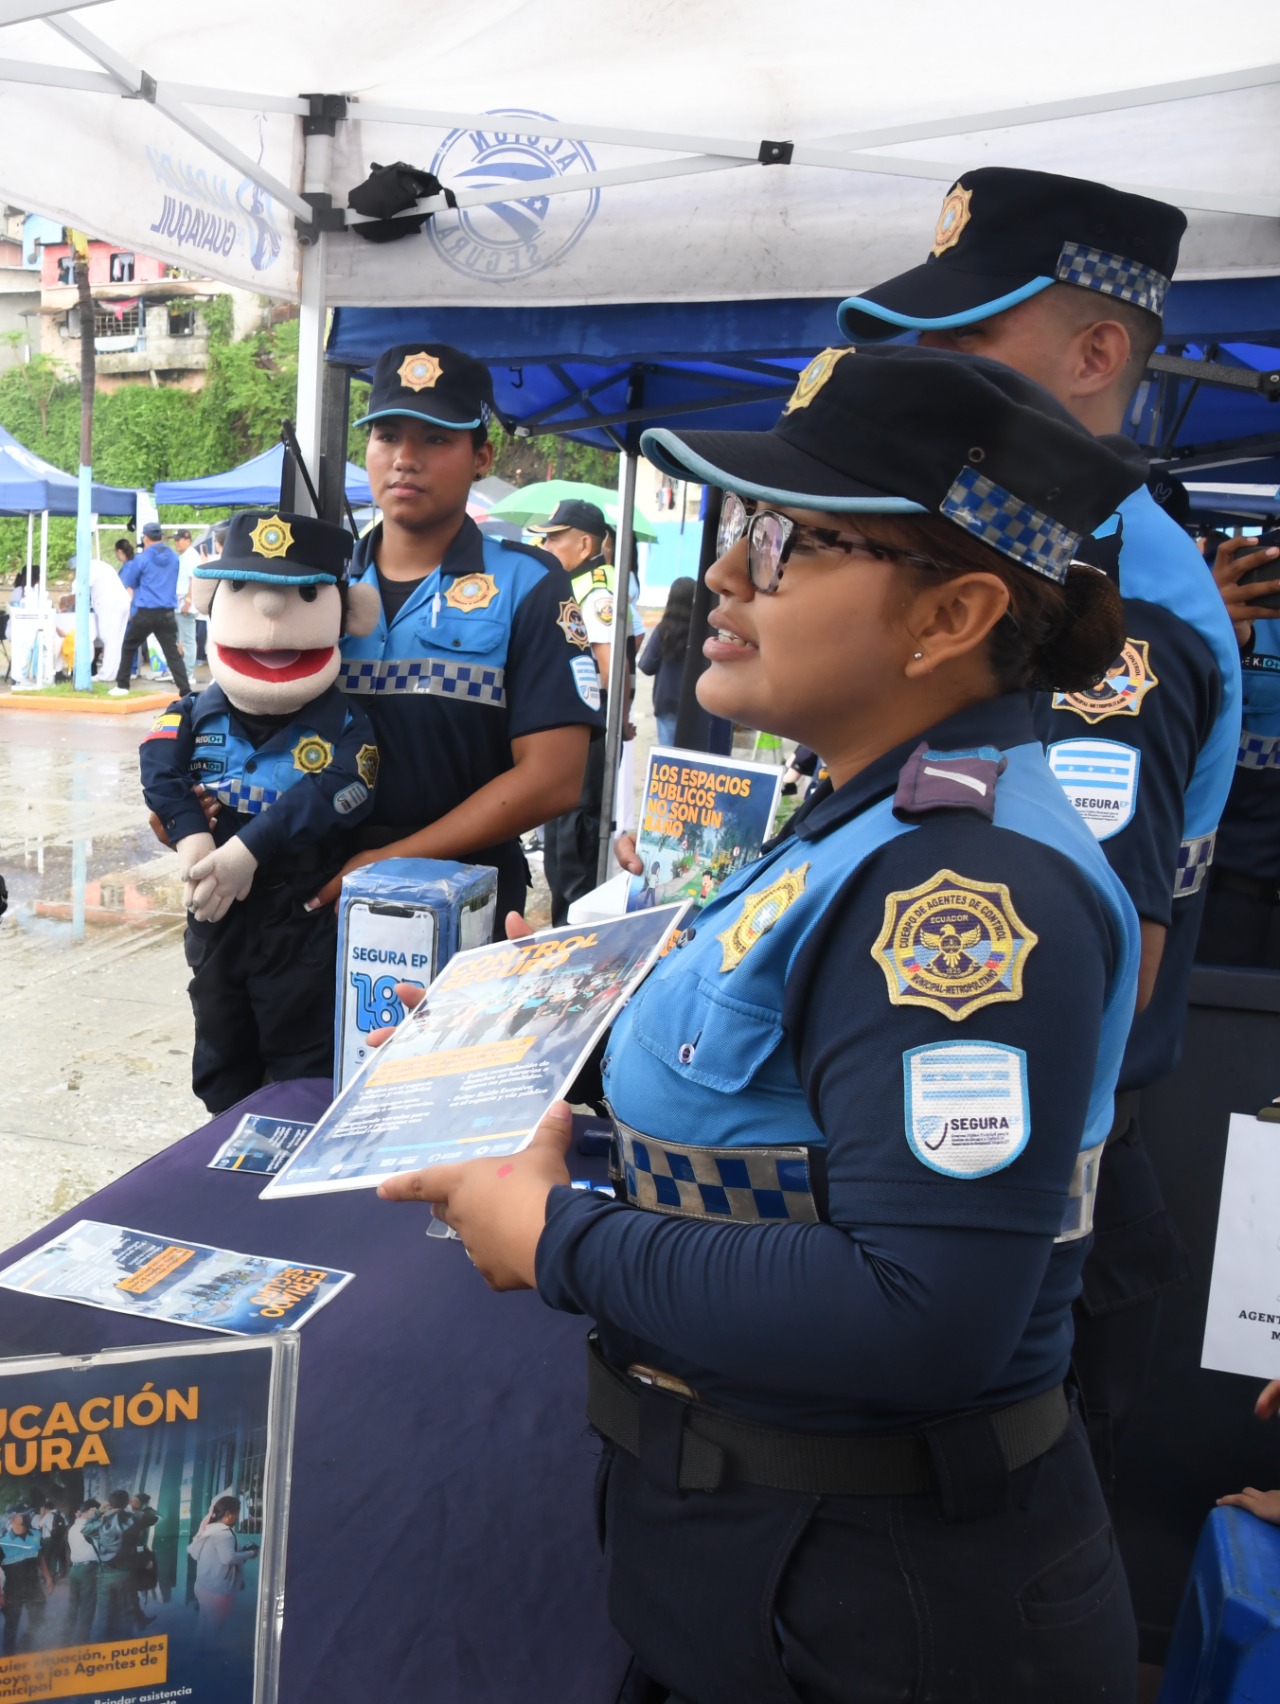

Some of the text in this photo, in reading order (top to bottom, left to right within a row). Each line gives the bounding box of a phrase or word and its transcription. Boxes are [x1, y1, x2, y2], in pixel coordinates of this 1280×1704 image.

[1125, 651, 1142, 677] CONTROL
[652, 763, 752, 797] LOS ESPACIOS
[647, 798, 723, 828] NO SON UN
[1074, 797, 1120, 810] SEGURA
[899, 895, 1008, 949] CUERPO DE AGENTES DE CONTROL
[930, 914, 969, 924] ECUADOR
[352, 946, 428, 968] SEGURA EP
[451, 932, 599, 977] CONTROL
[439, 951, 570, 993] SEGURO
[350, 971, 425, 1033] 18
[950, 1117, 1009, 1131] SEGURA
[260, 1268, 328, 1318] FERIADO
[111, 1640, 164, 1661] puedes
[48, 1665, 70, 1680] los
[74, 1657, 135, 1678] Agentes
[139, 1653, 158, 1666] de
[139, 1685, 193, 1703] asistencia
